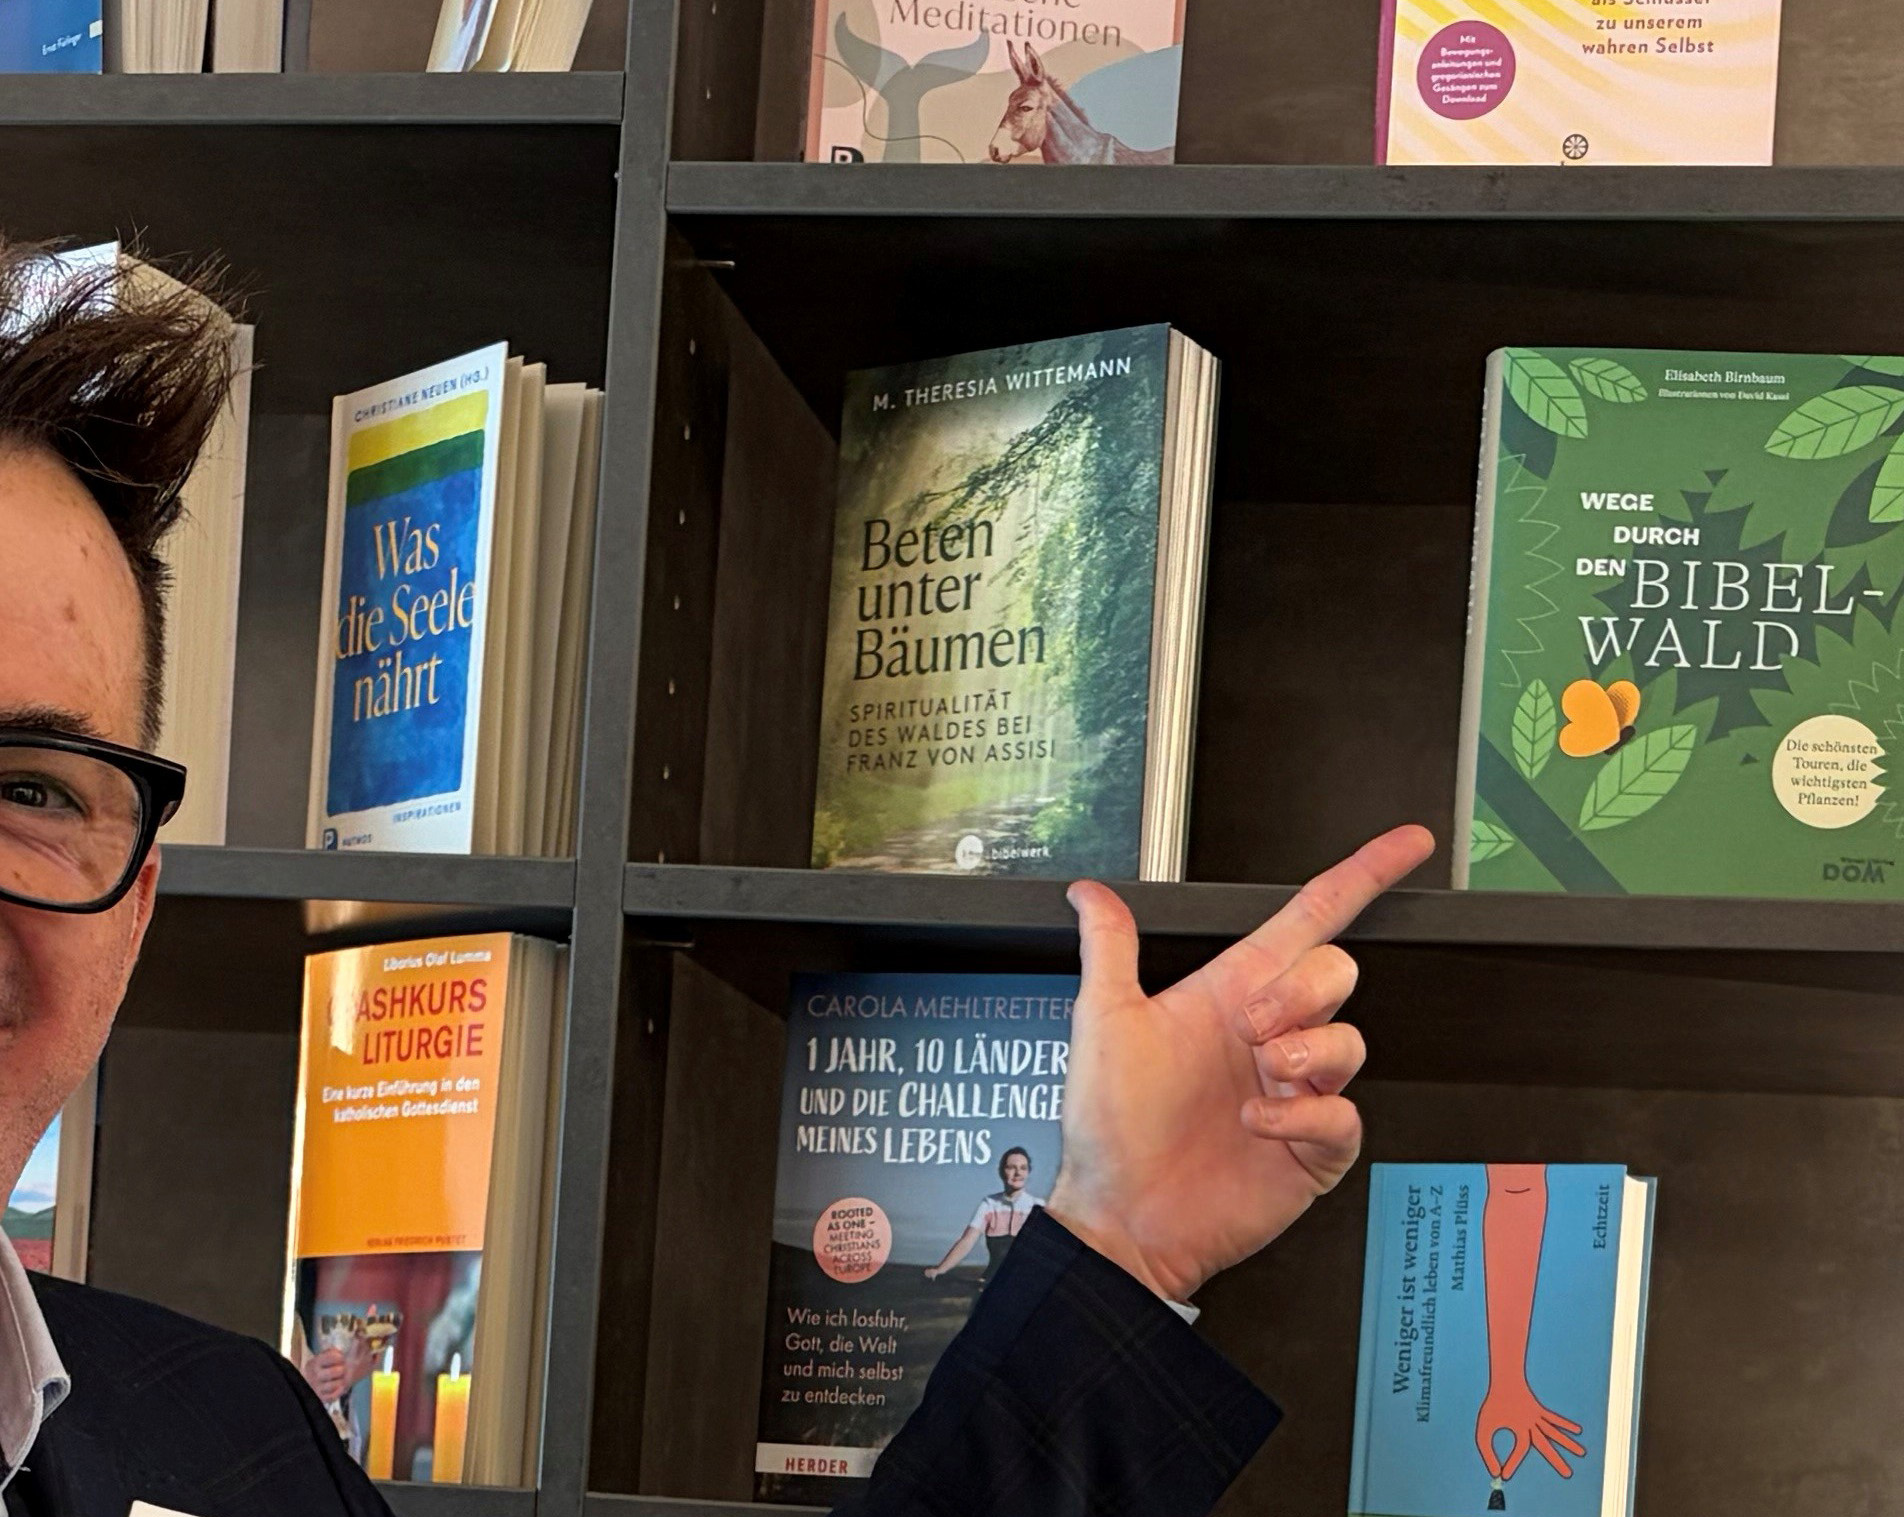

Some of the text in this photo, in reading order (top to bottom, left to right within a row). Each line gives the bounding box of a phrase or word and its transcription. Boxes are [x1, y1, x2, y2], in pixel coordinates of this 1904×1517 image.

[889, 0, 1122, 48] Meditationen
[1596, 17, 1703, 30] zu unserem
[1582, 37, 1714, 55] wahren Selbst
[904, 356, 1132, 408] THERESIA WITTEMANN
[1664, 368, 1786, 384] Elisabeth Birnbaum
[354, 378, 458, 423] CHRISTIANE NEUEN
[1580, 492, 1654, 512] WEGE
[373, 515, 441, 581] Was
[861, 516, 993, 573] Beten
[1613, 526, 1700, 547] DURCH
[857, 571, 983, 623] unter
[1576, 557, 1884, 615] DEN BIBEL-
[335, 565, 478, 660] die Seele
[853, 622, 1046, 682] Bäumen
[1578, 615, 1800, 672] WALD
[353, 651, 444, 724] nährt
[850, 688, 1013, 724] SPIRITUALITÄT
[848, 714, 1032, 749] DES WALDES BEI
[1786, 739, 1879, 755] Die schönsten
[846, 739, 1056, 774] FRANZ VON ASSISI
[1792, 756, 1867, 773] Touren, die
[1790, 775, 1867, 790] wichtigsten
[1798, 792, 1860, 807] Pflanzen!
[807, 994, 907, 1019] CAROLA
[362, 1023, 485, 1066] LITURGIE
[824, 1032, 1069, 1076] JAHR, 10 LÄNDER
[376, 1078, 438, 1099] Einführung
[800, 1081, 1065, 1121] UND DIE CHALLENGE
[332, 1097, 479, 1123] katholischen Gottesdienst
[796, 1125, 992, 1165] MEINES LEBENS
[1592, 1184, 1610, 1249] Echtzeit
[1451, 1185, 1469, 1291] Mathias Plüss
[1392, 1185, 1425, 1394] Weniger ist weniger
[787, 1307, 909, 1332] Wie ich losfuhr,
[1416, 1220, 1442, 1423] Klimafreundlich leben von
[829, 1334, 897, 1354] die Welt
[783, 1360, 904, 1381] und mich selbst
[781, 1387, 886, 1406] zu entdecken
[784, 1457, 848, 1474] HERDER
